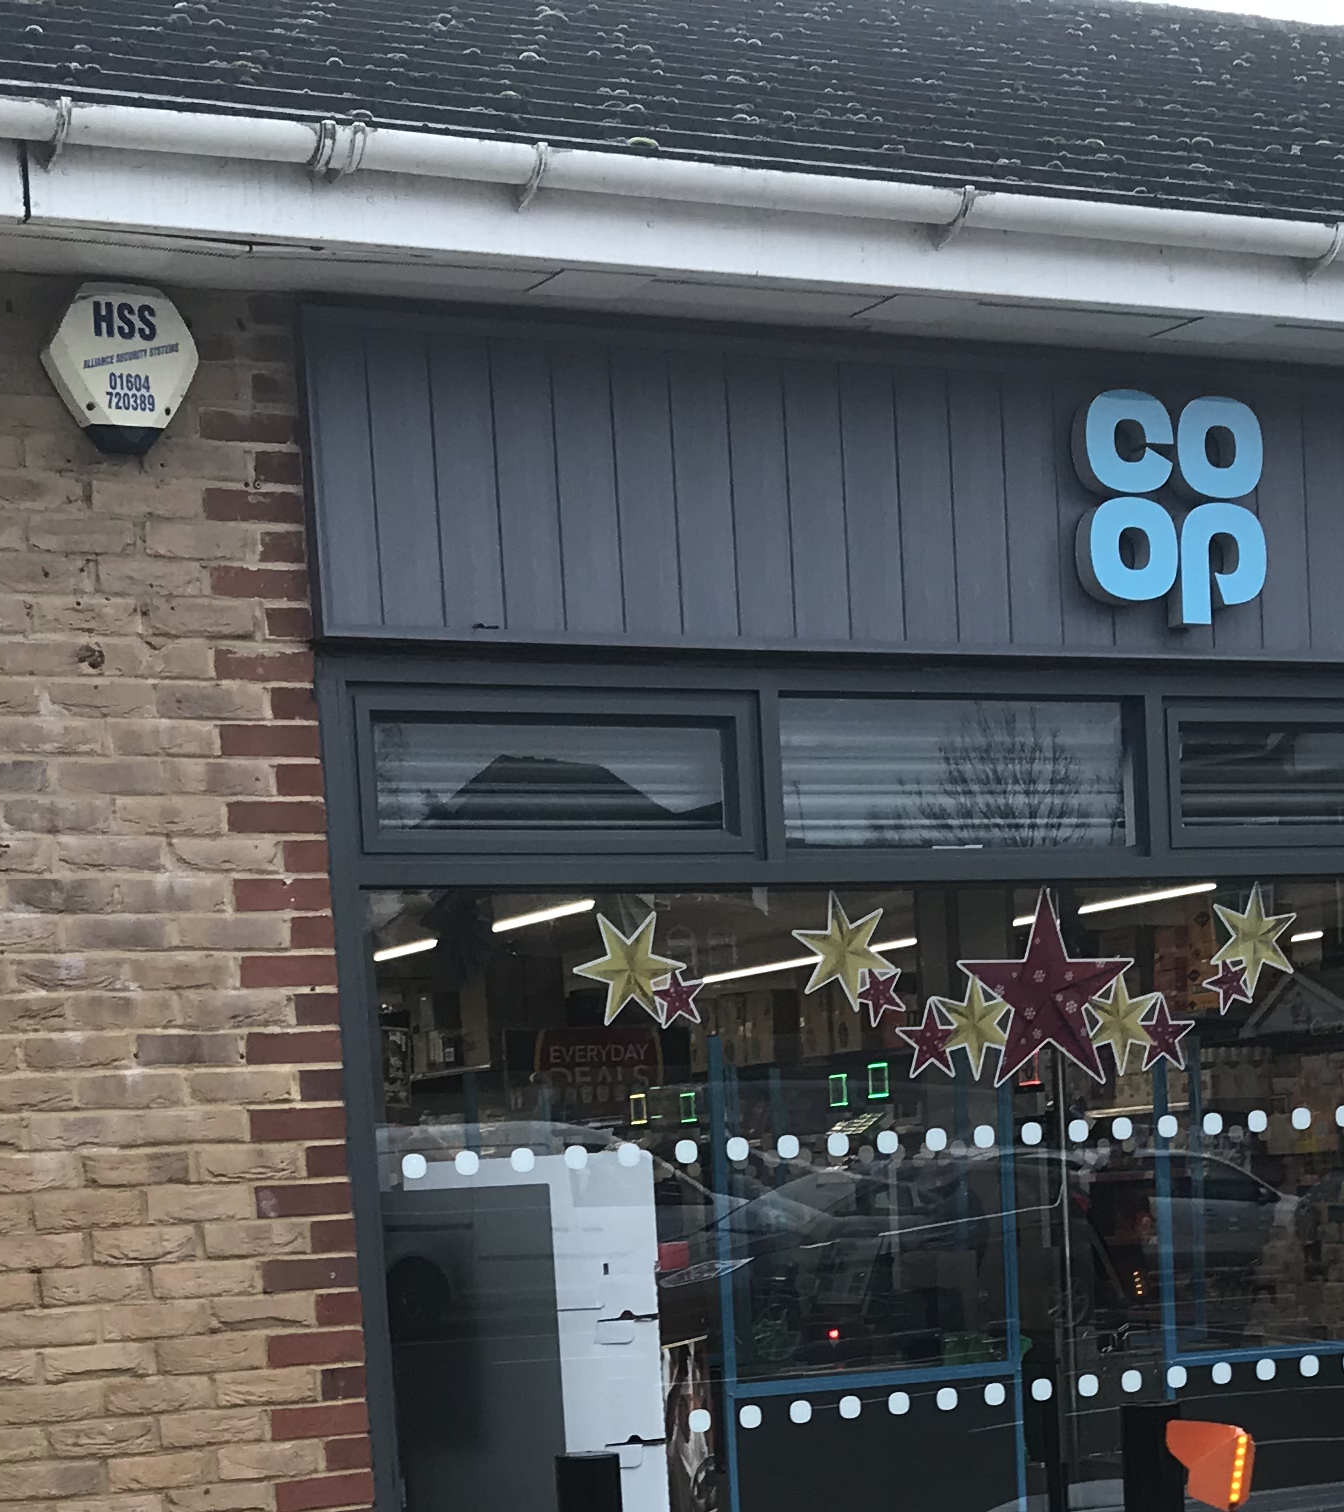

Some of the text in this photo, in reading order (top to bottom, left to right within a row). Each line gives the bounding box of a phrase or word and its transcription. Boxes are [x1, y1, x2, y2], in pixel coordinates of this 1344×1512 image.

[93, 300, 156, 341] HSS
[109, 372, 150, 392] 01604
[106, 391, 155, 412] 720389
[549, 1044, 648, 1063] EVERYDAY
